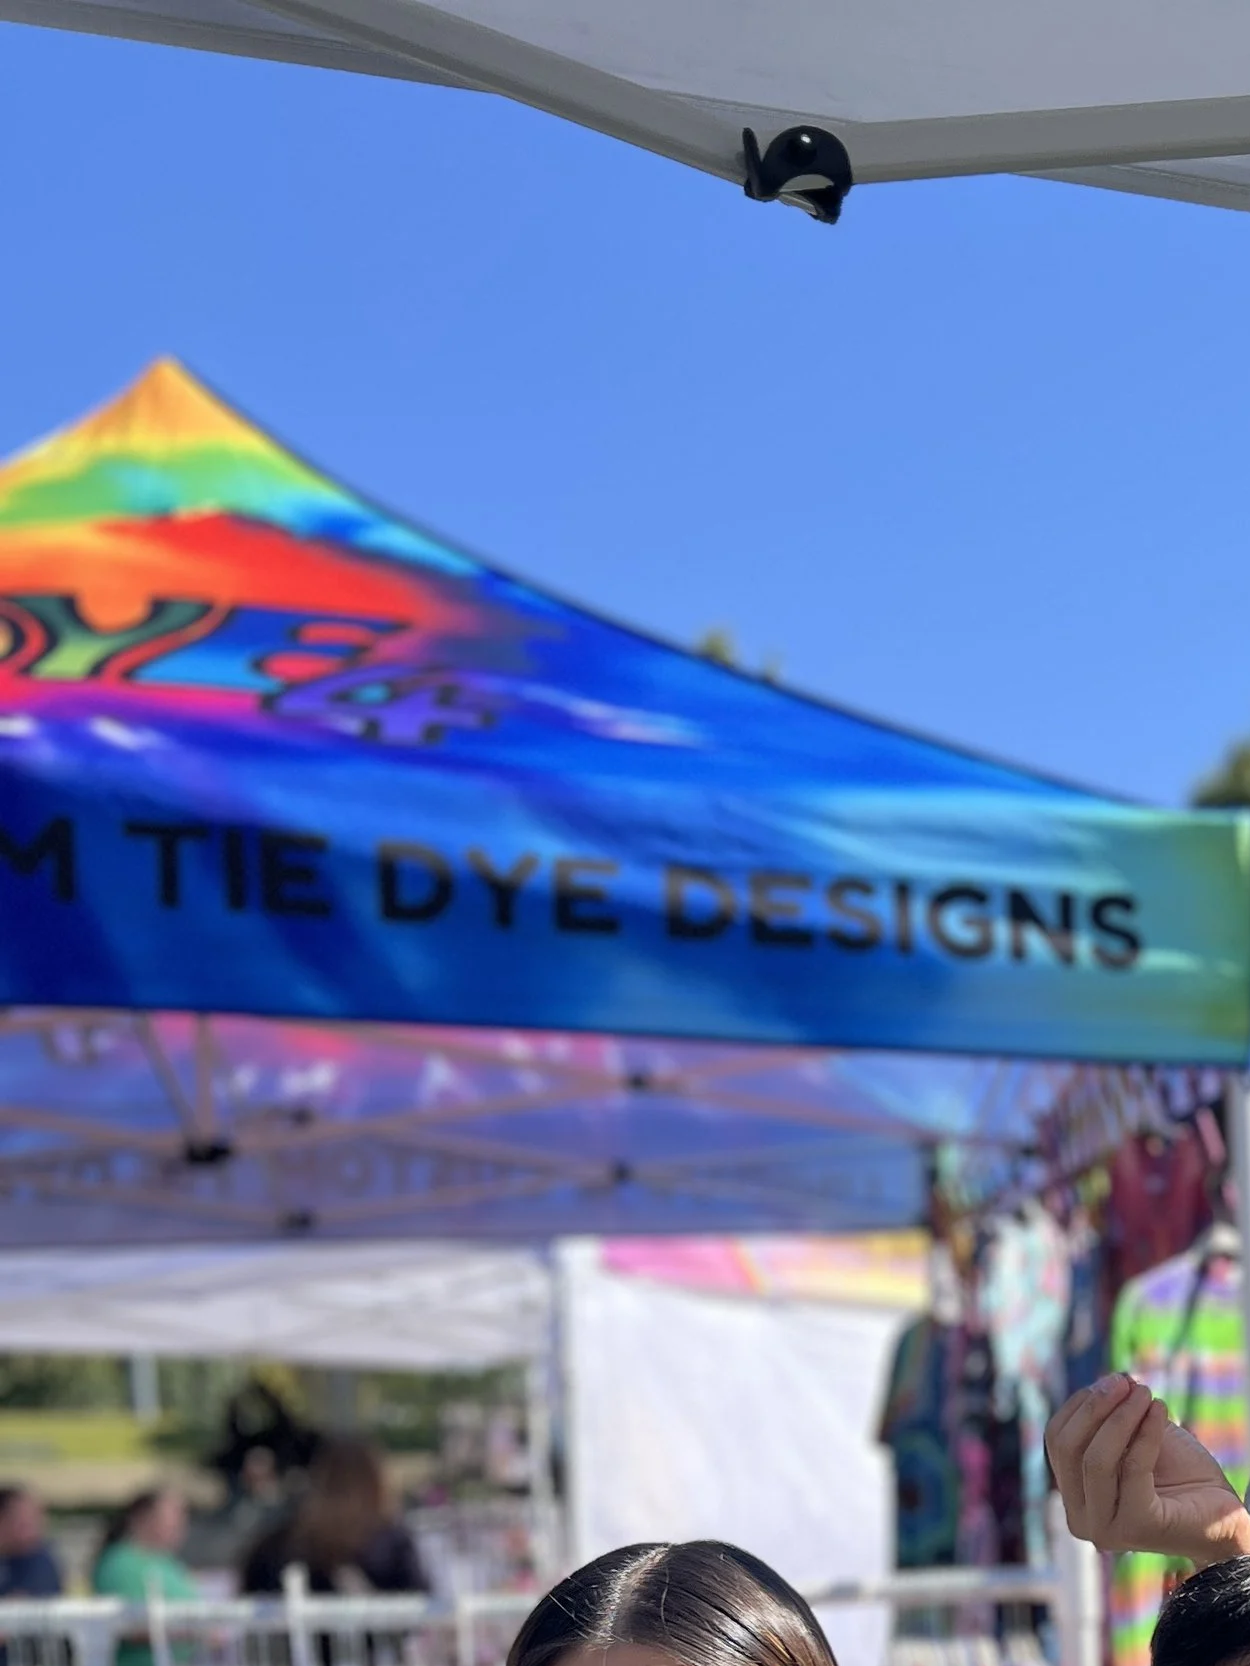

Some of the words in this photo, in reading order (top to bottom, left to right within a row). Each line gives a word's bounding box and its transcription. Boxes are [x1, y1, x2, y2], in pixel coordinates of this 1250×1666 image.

[0, 590, 412, 693] YE
[122, 818, 332, 916] TIE
[376, 836, 620, 934] DYE
[664, 863, 1144, 971] DESIGNS
